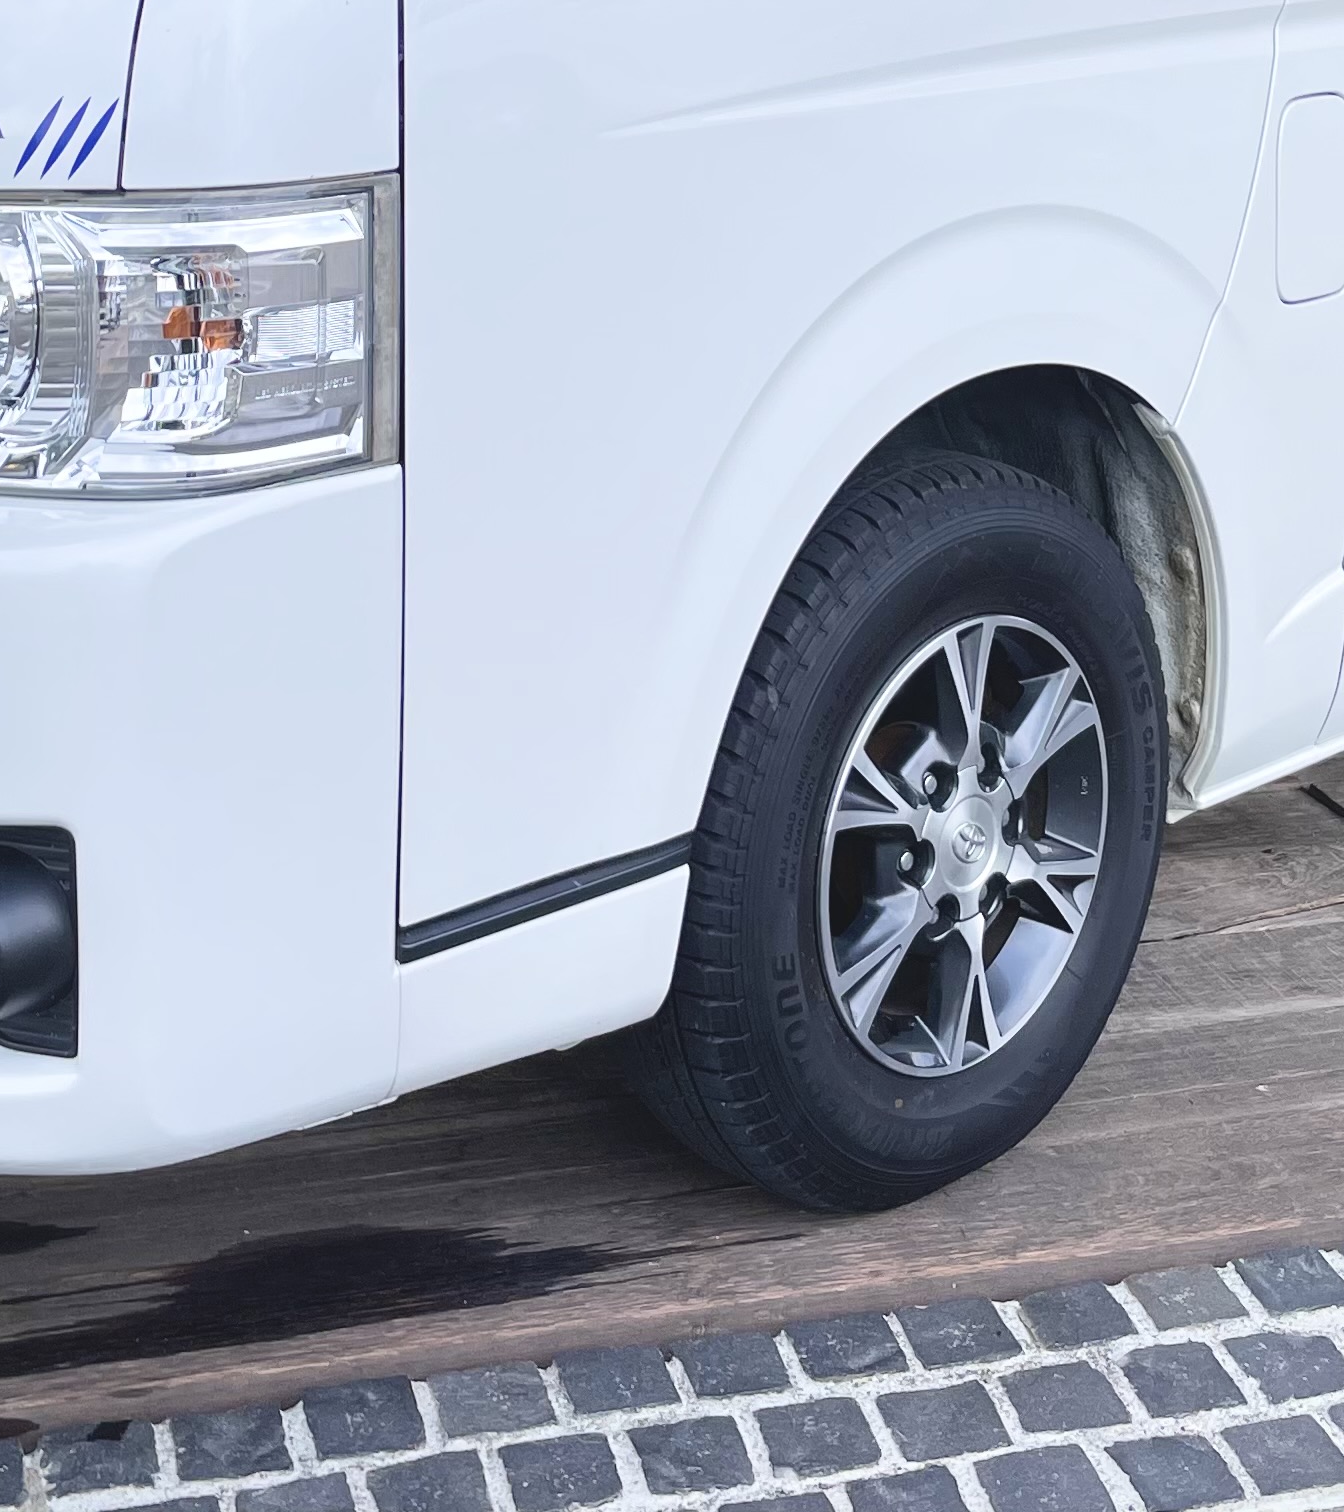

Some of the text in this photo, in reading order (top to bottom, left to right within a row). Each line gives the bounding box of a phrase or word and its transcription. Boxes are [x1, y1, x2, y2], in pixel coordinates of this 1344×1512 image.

[781, 810, 797, 850] LOAD
[790, 748, 815, 806] SINGLE
[1140, 725, 1156, 841] CAMPER
[792, 816, 805, 855] LOAD
